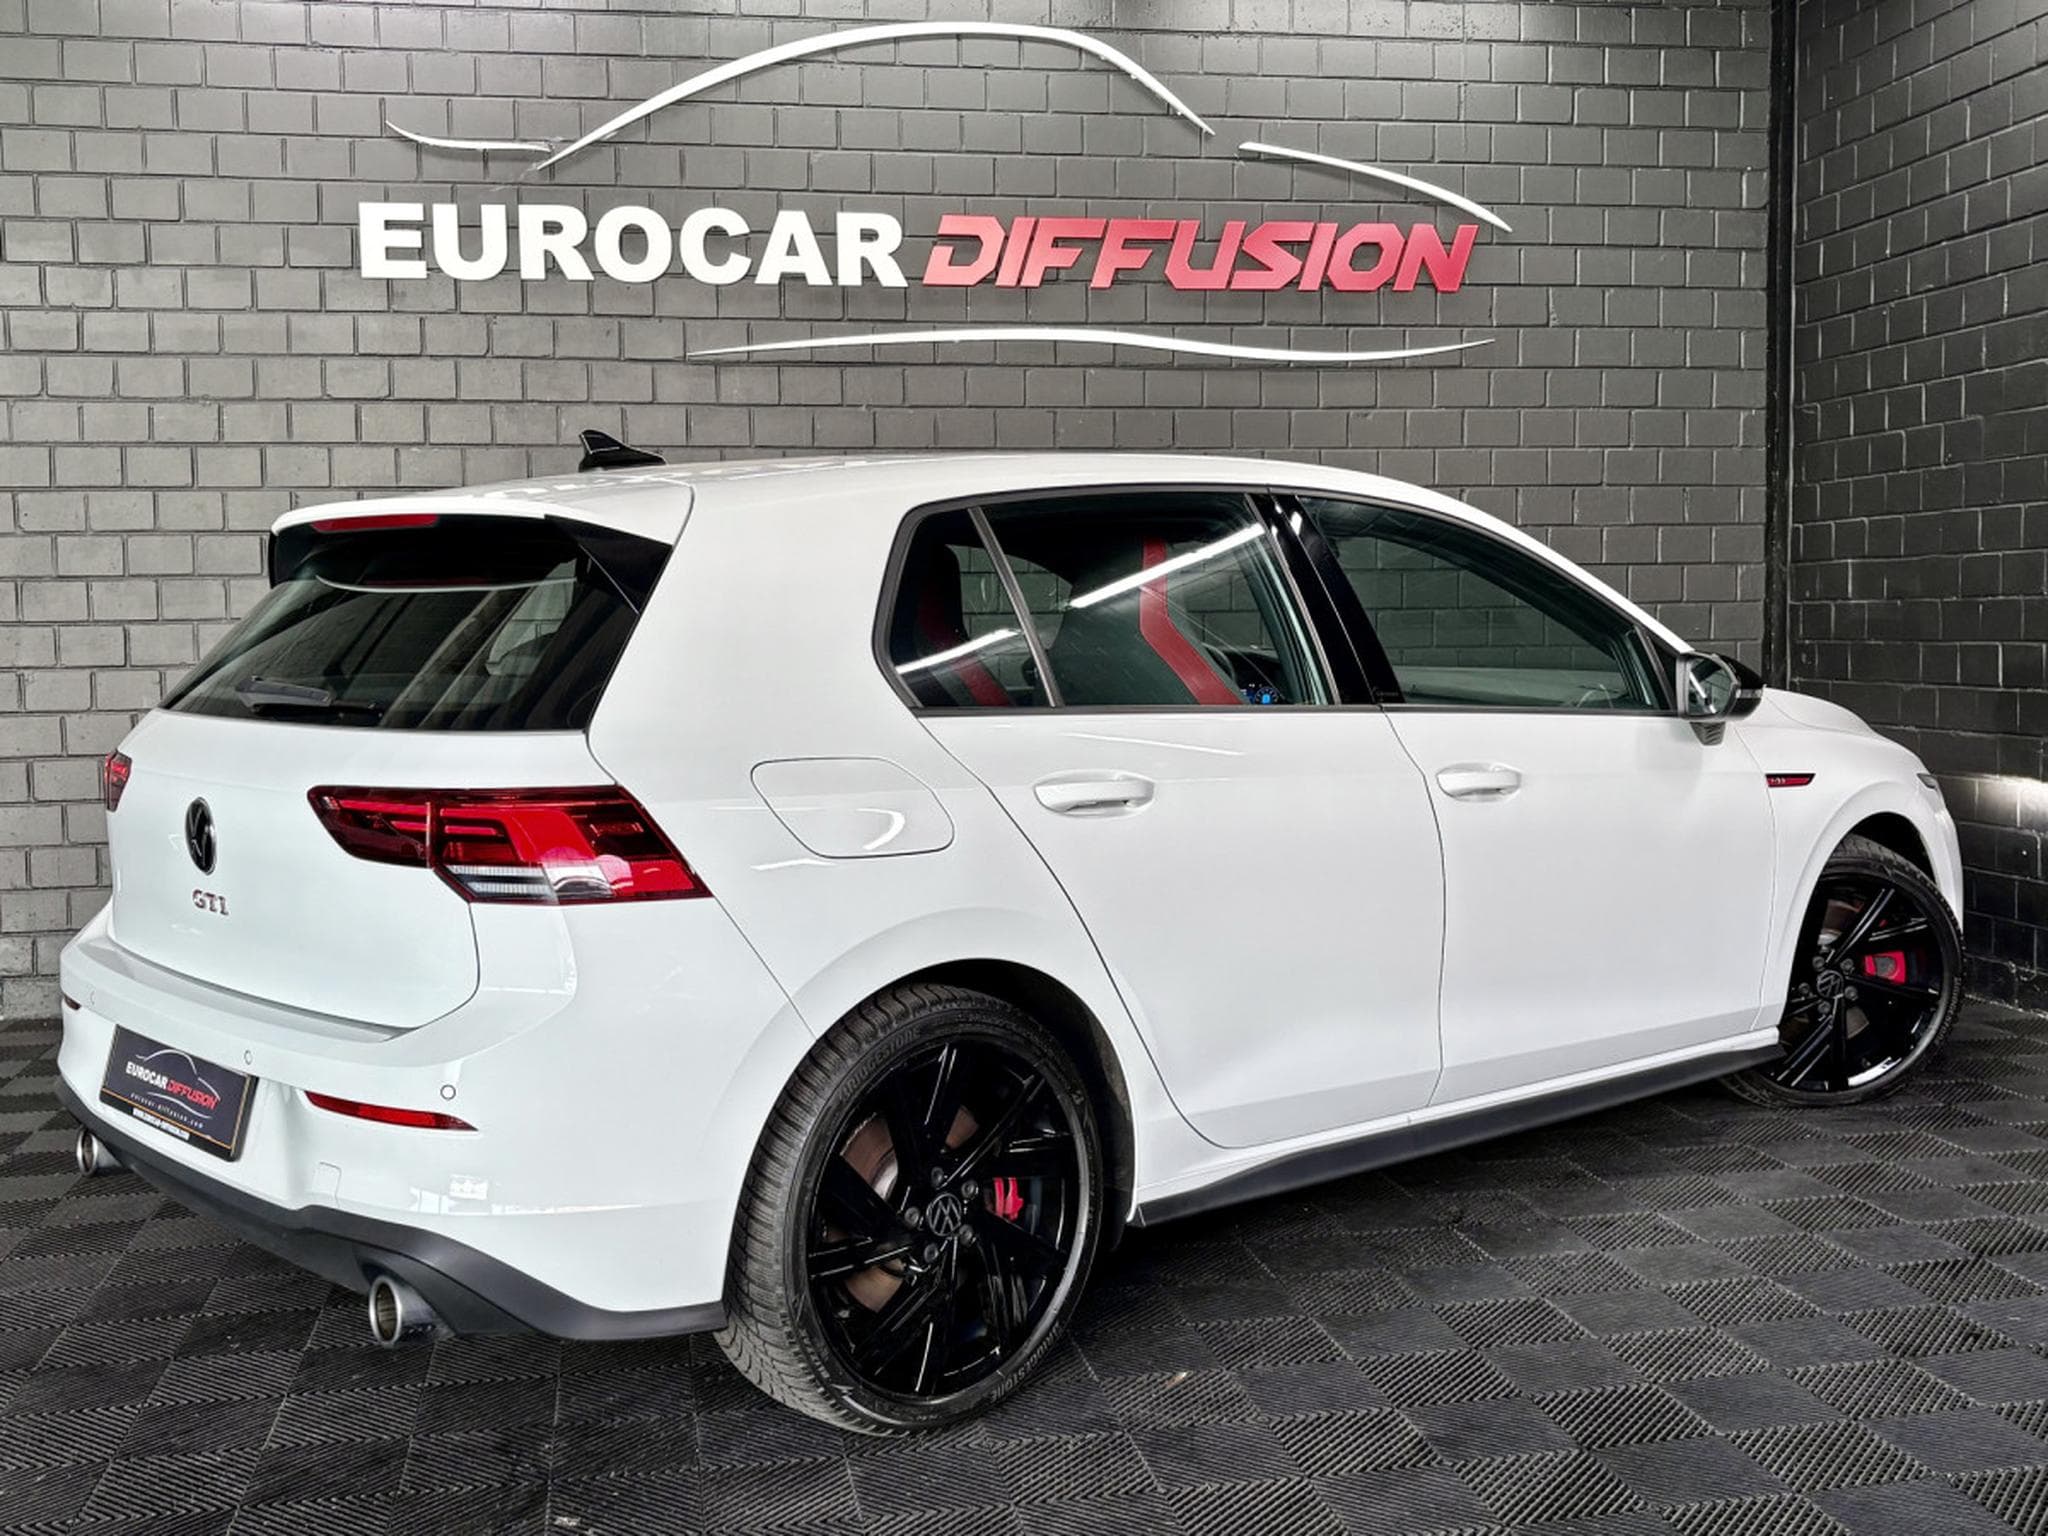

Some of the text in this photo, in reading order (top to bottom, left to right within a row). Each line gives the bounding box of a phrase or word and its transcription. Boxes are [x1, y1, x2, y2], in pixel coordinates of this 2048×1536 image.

[357, 201, 1479, 293] EUROCAR DIFFUSION
[192, 889, 229, 916] GTI
[125, 1061, 219, 1110] EUROCAR DIFFUSION
